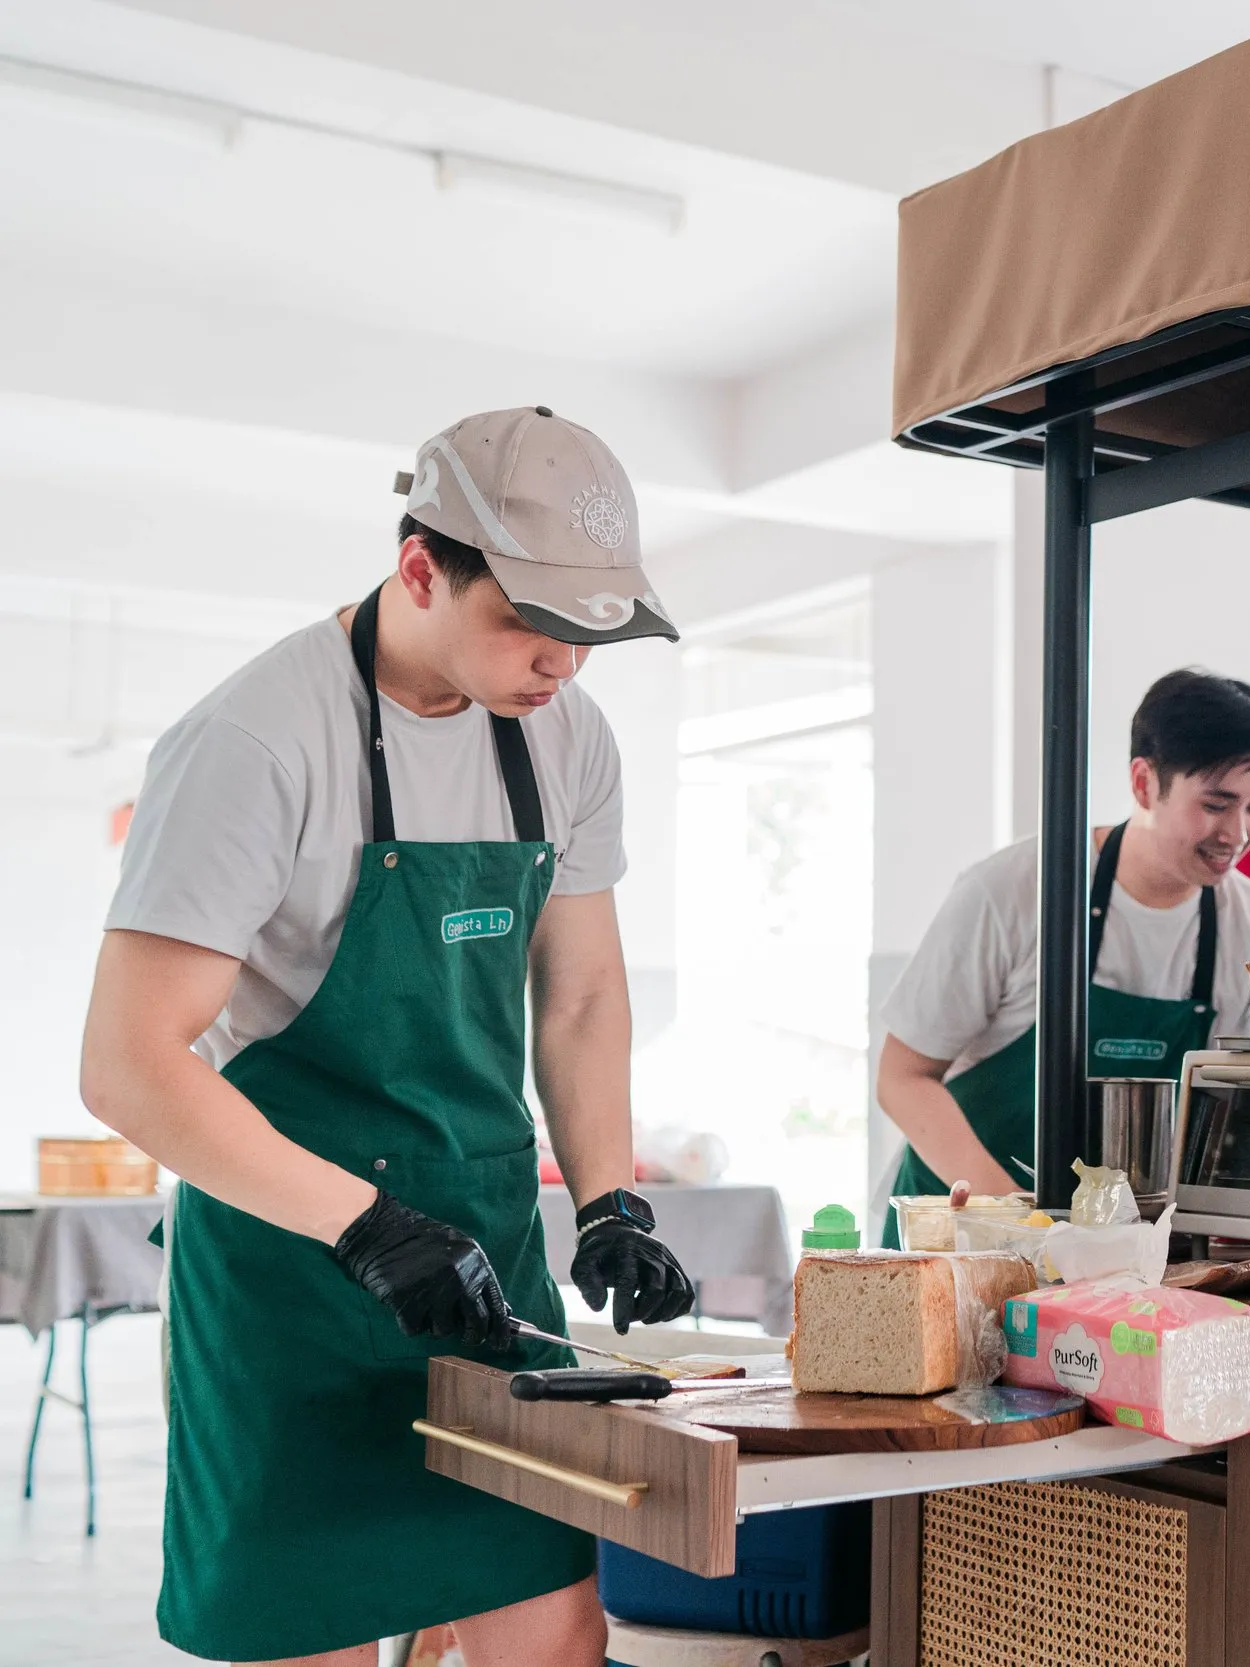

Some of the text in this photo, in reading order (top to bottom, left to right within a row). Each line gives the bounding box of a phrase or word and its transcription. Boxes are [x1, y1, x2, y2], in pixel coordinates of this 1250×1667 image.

[447, 914, 506, 937] Genista Ln
[1054, 1348, 1099, 1373] PurSoft
